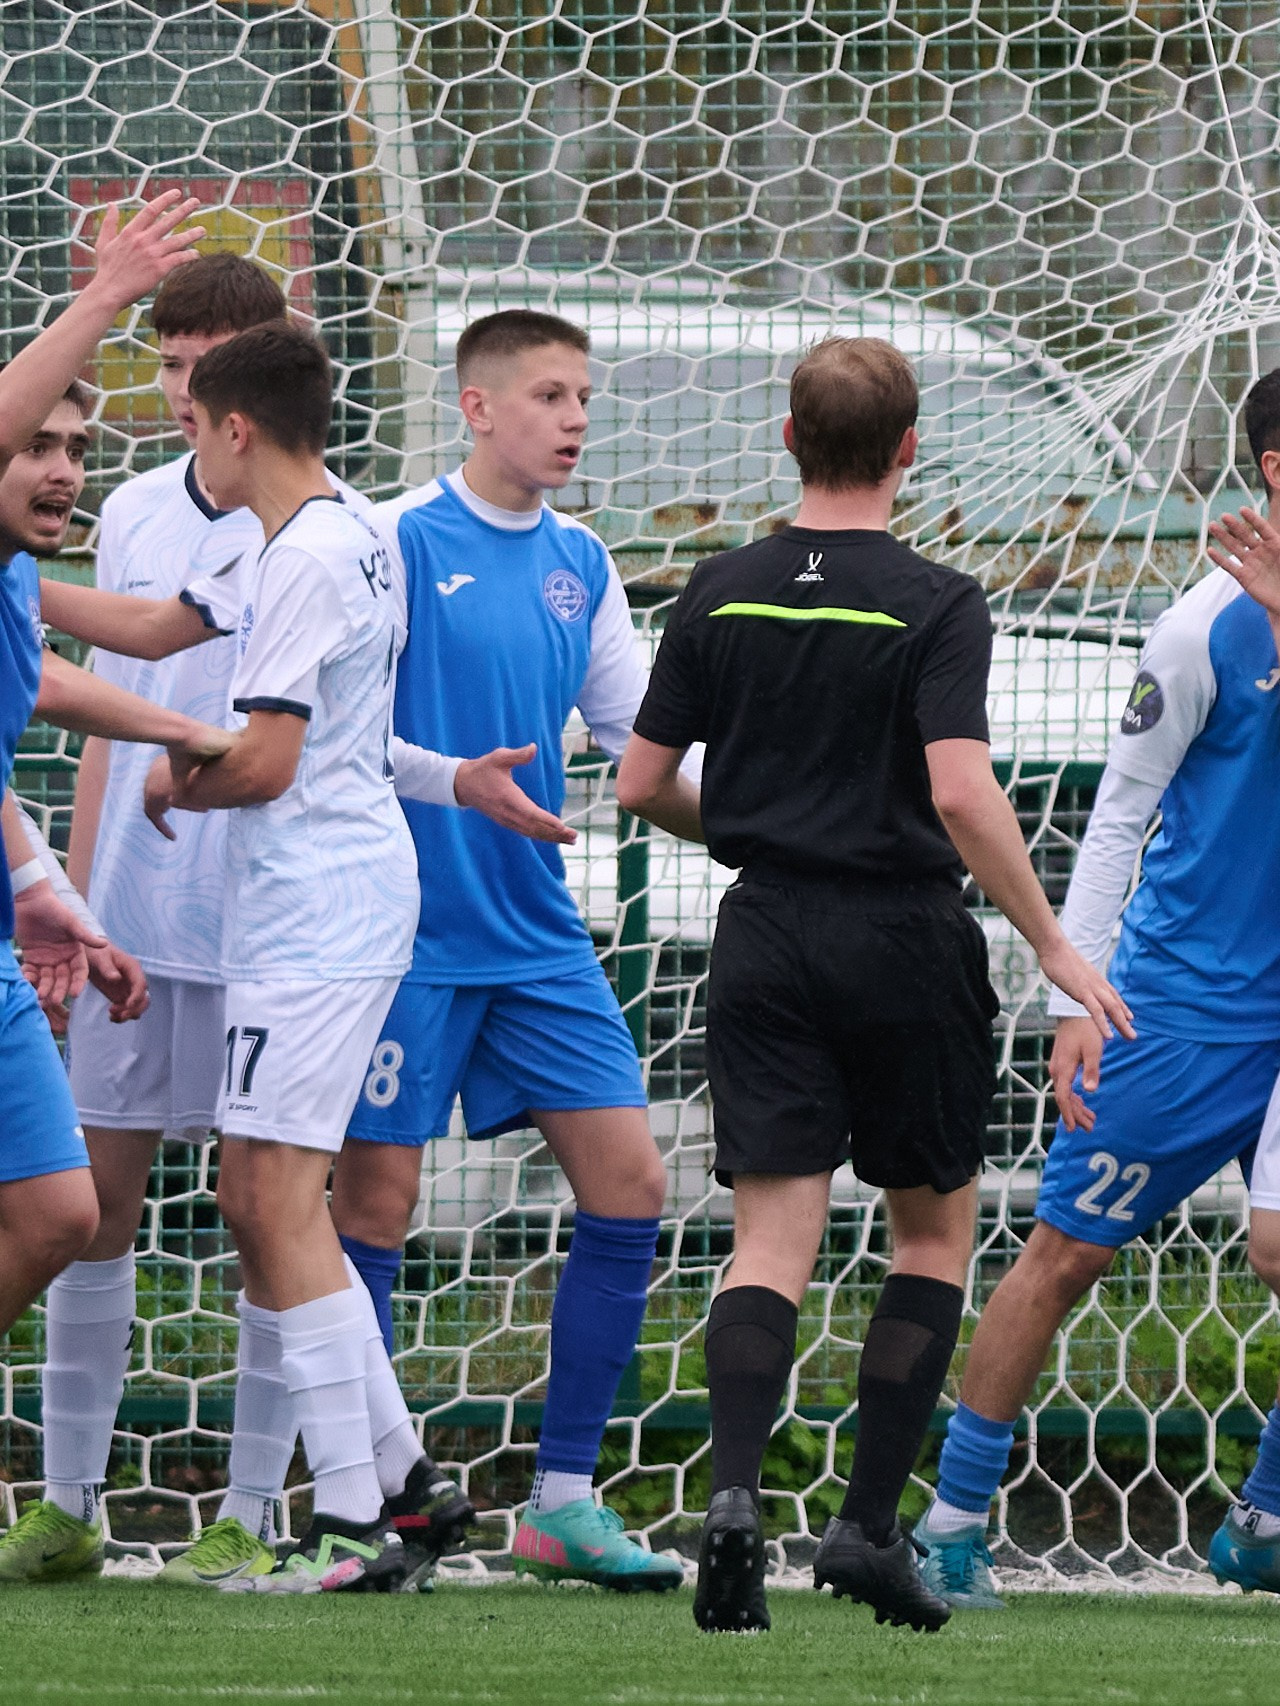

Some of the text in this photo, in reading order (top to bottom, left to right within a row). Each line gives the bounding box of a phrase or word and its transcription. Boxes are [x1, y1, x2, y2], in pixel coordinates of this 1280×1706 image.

[226, 1025, 270, 1097] 17
[364, 1039, 405, 1108] 8
[1074, 1151, 1151, 1221] 22
